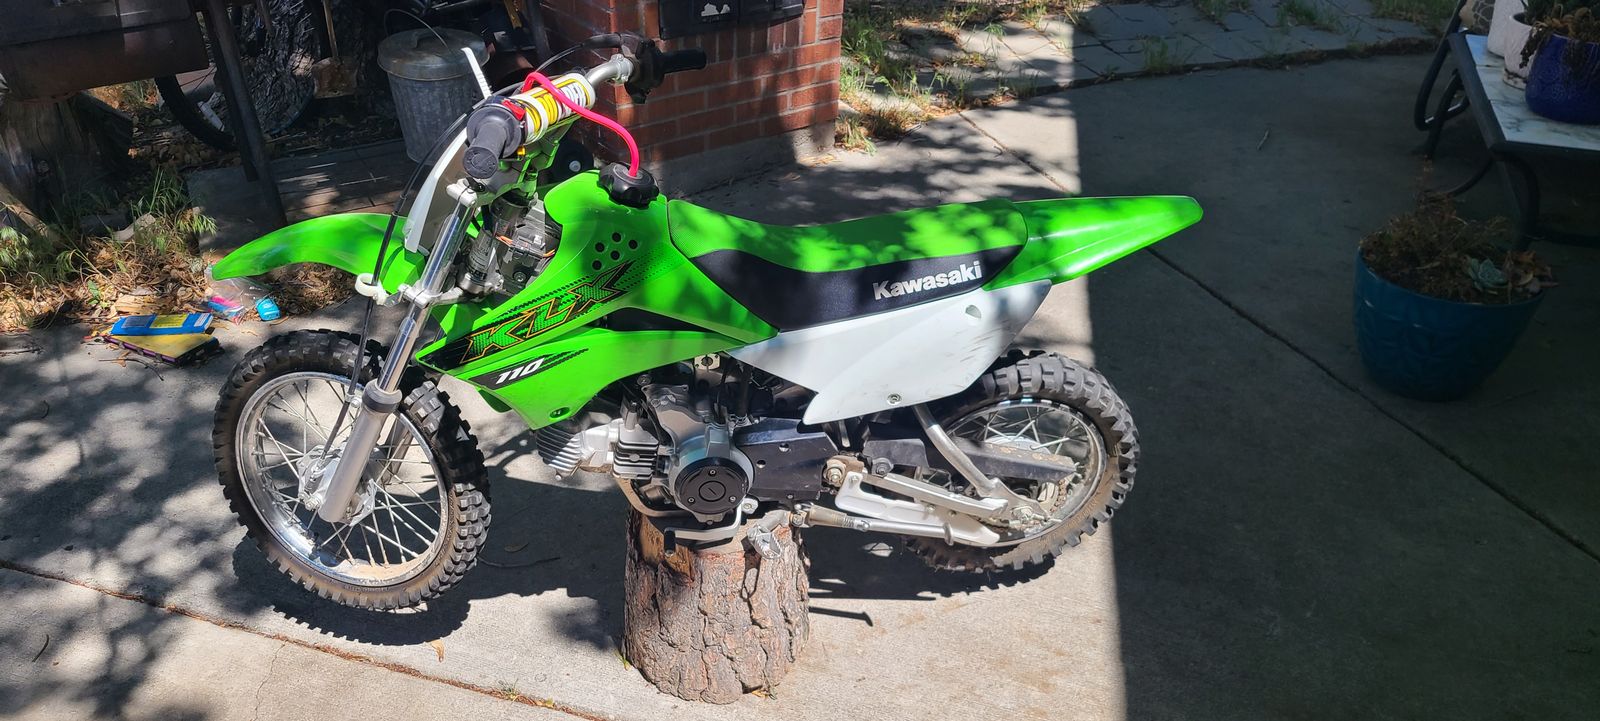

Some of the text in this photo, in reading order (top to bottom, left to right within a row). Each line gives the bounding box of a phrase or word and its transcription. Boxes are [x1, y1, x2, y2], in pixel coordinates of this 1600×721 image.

[872, 260, 983, 300] Kawasaki
[459, 261, 630, 364] KLX
[495, 357, 545, 385] 110
